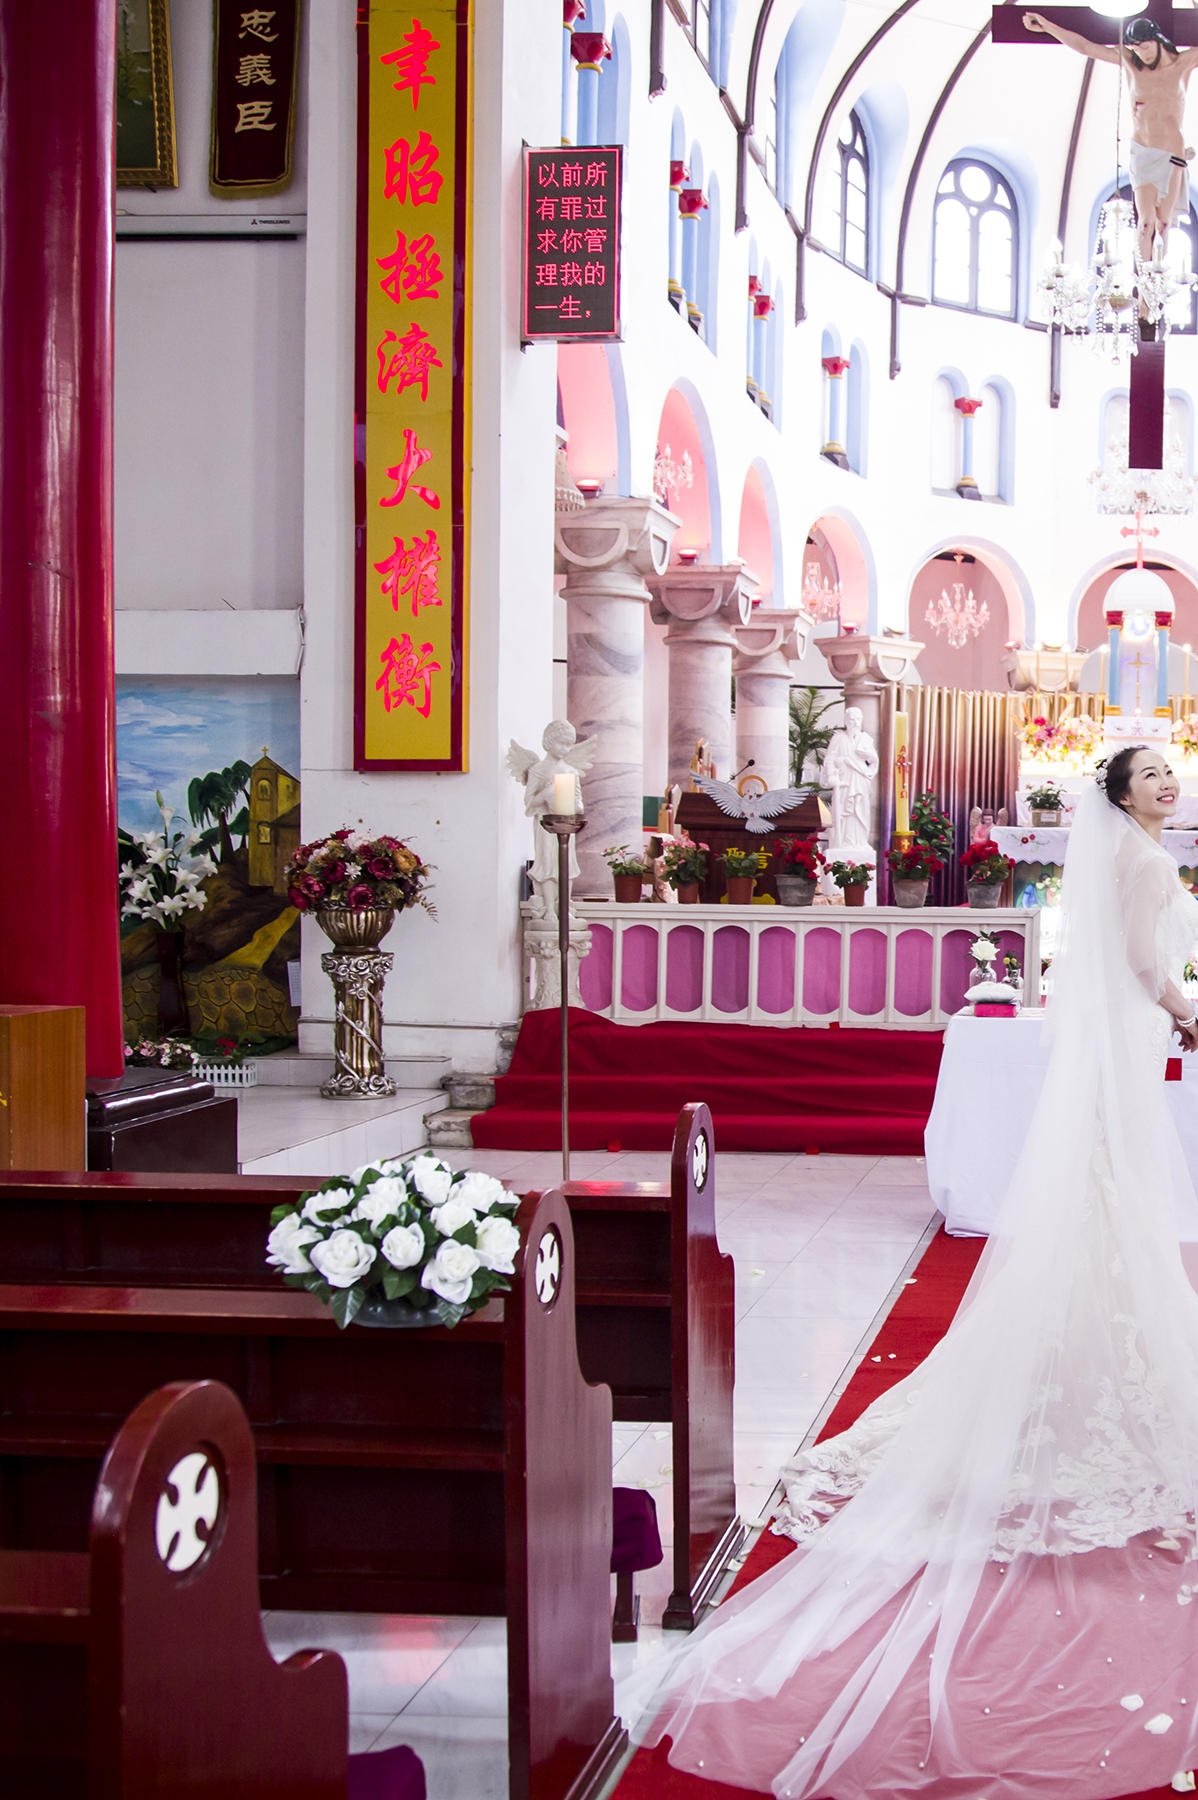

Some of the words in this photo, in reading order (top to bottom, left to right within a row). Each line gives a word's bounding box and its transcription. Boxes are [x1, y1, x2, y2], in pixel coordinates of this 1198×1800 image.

[235, 9, 278, 133] 忠義臣
[537, 161, 608, 188] 以前所
[535, 194, 608, 221] 有罪过
[536, 227, 608, 254] 求你管
[535, 261, 606, 287] 理我的
